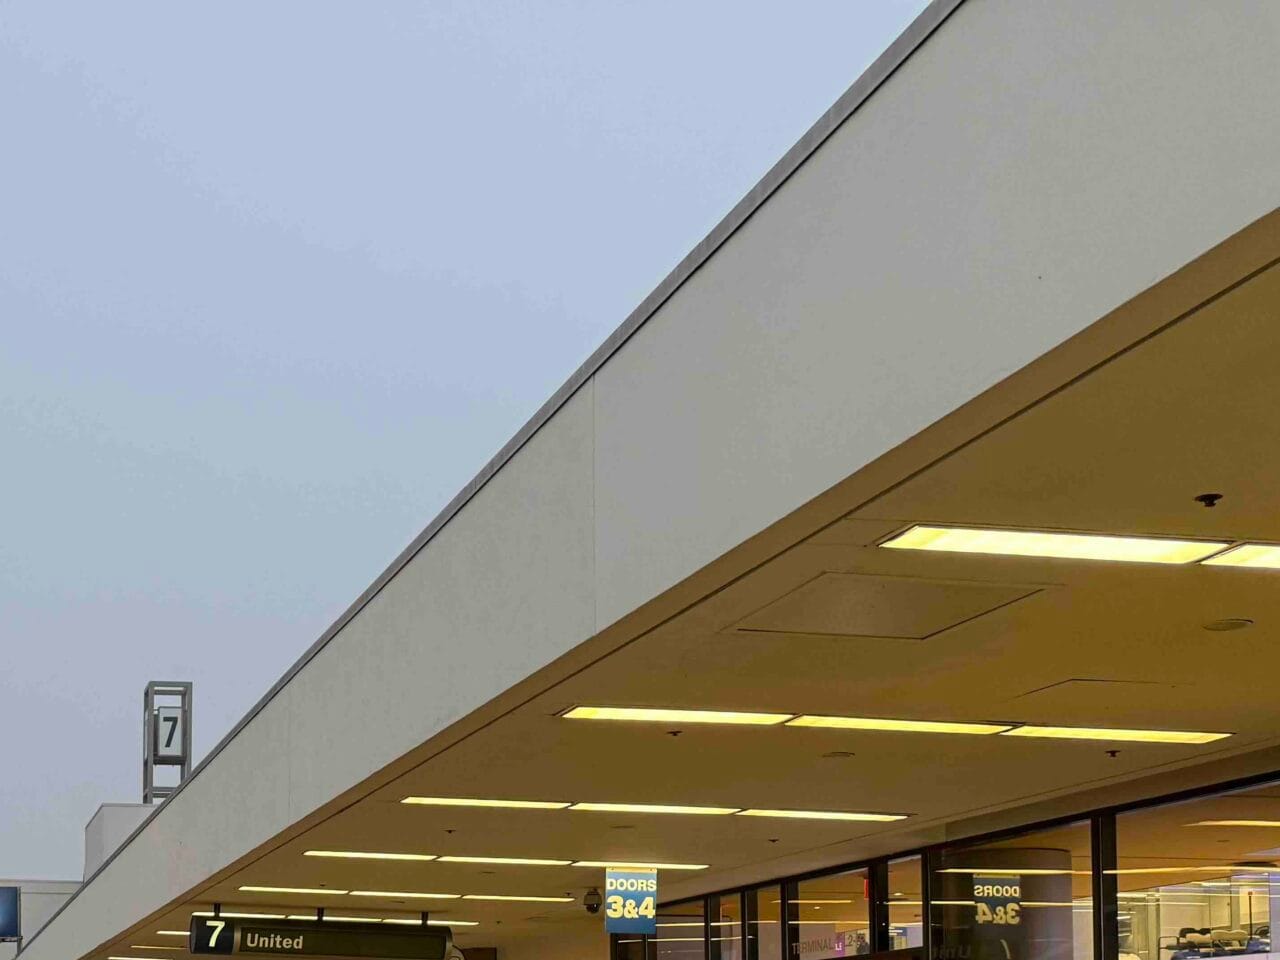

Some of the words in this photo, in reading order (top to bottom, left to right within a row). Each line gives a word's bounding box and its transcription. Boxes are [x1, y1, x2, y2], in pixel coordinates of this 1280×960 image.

[162, 716, 179, 748] 7
[606, 878, 657, 892] DOORS
[606, 895, 656, 919] 3&4
[205, 920, 226, 948] 7
[246, 933, 304, 950] United
